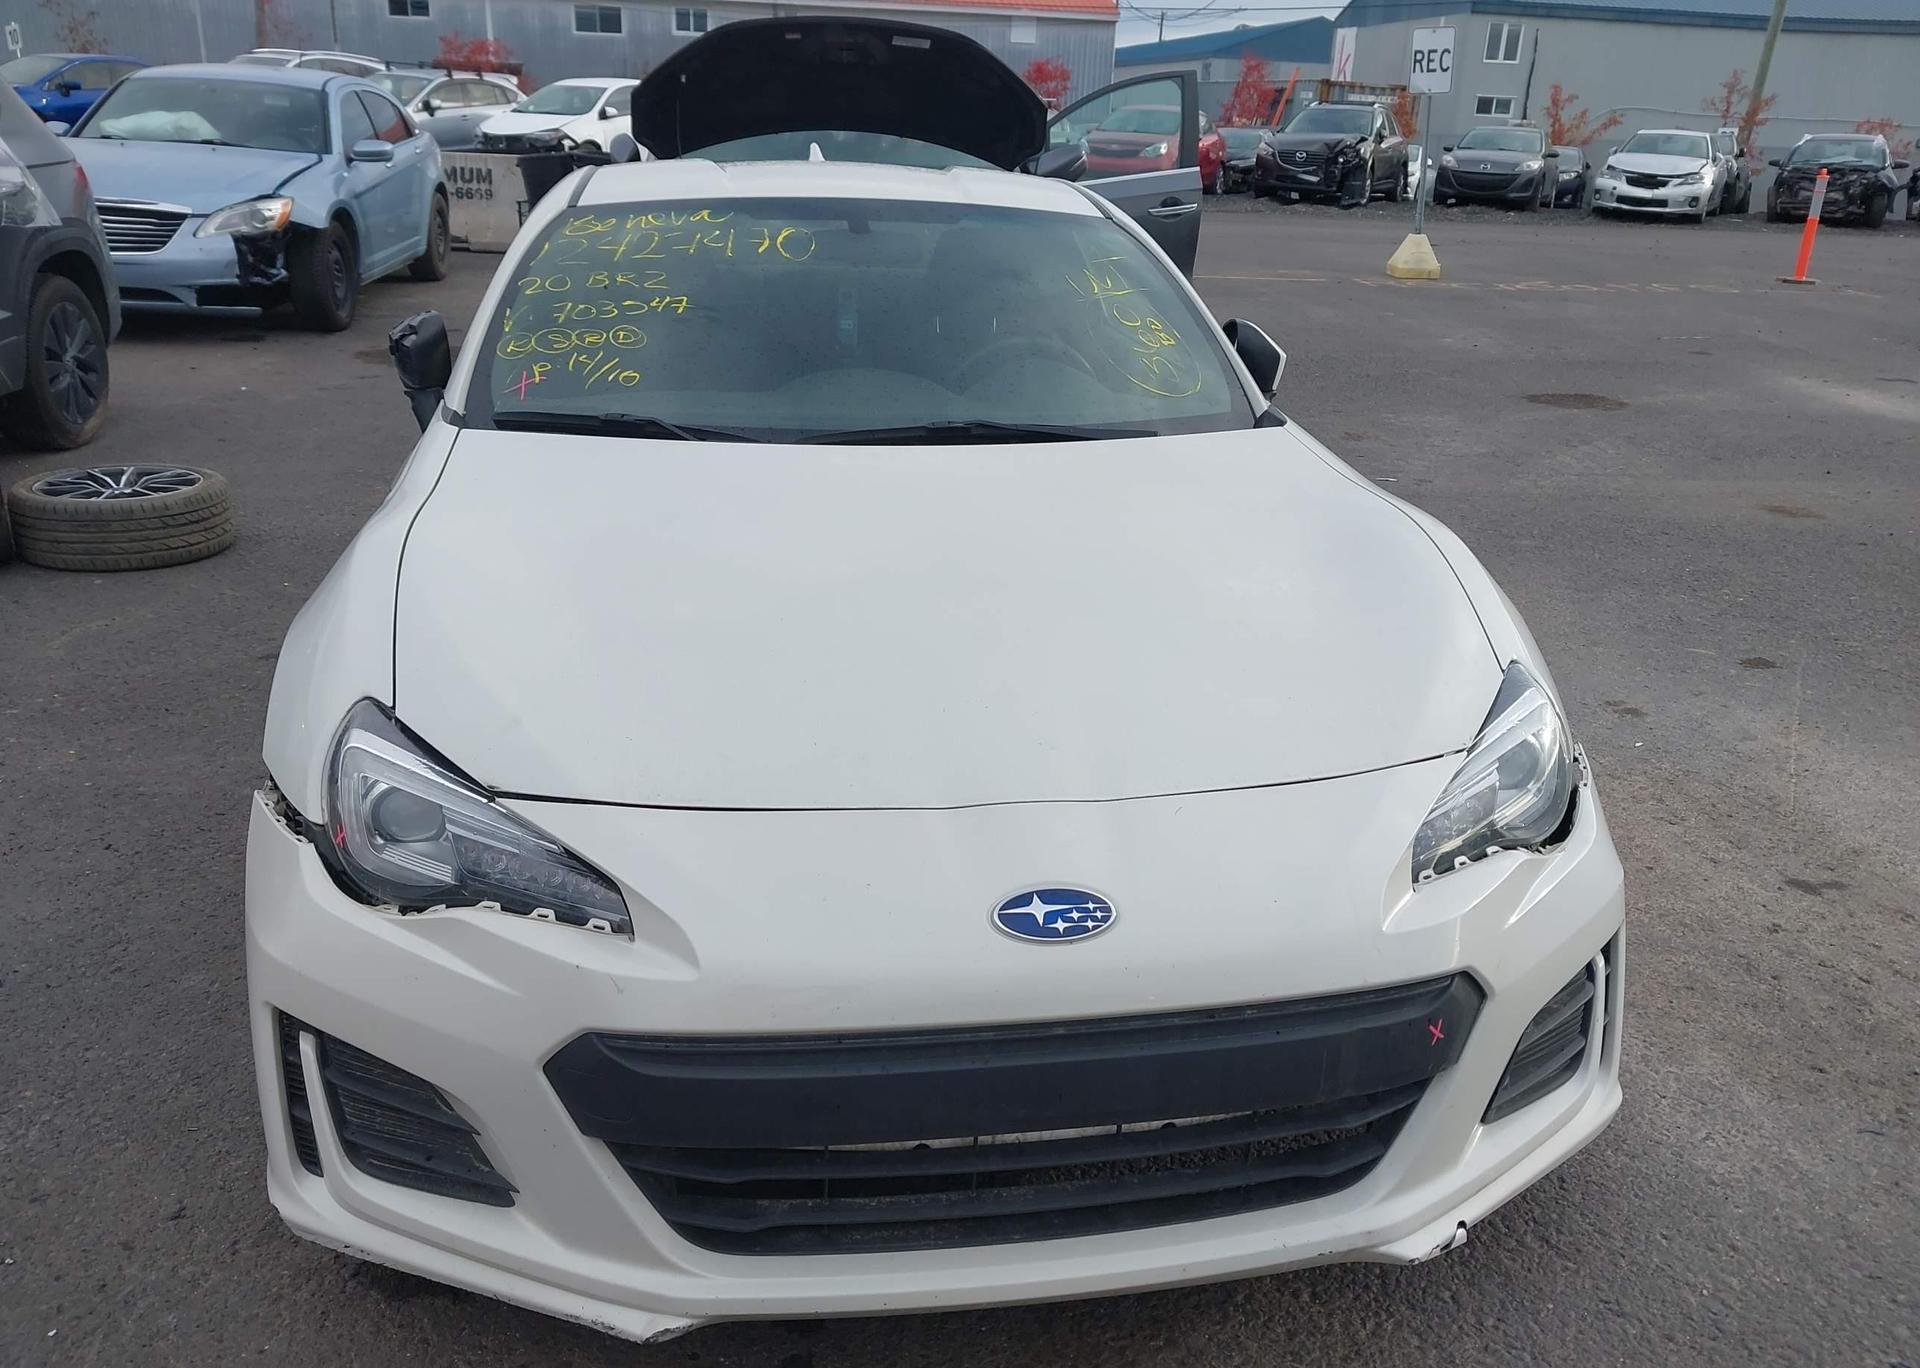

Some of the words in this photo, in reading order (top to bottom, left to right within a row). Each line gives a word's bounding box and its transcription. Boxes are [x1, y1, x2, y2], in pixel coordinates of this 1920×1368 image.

[1412, 48, 1451, 74] REC
[518, 274, 571, 295] 20
[586, 271, 669, 289] BRZ
